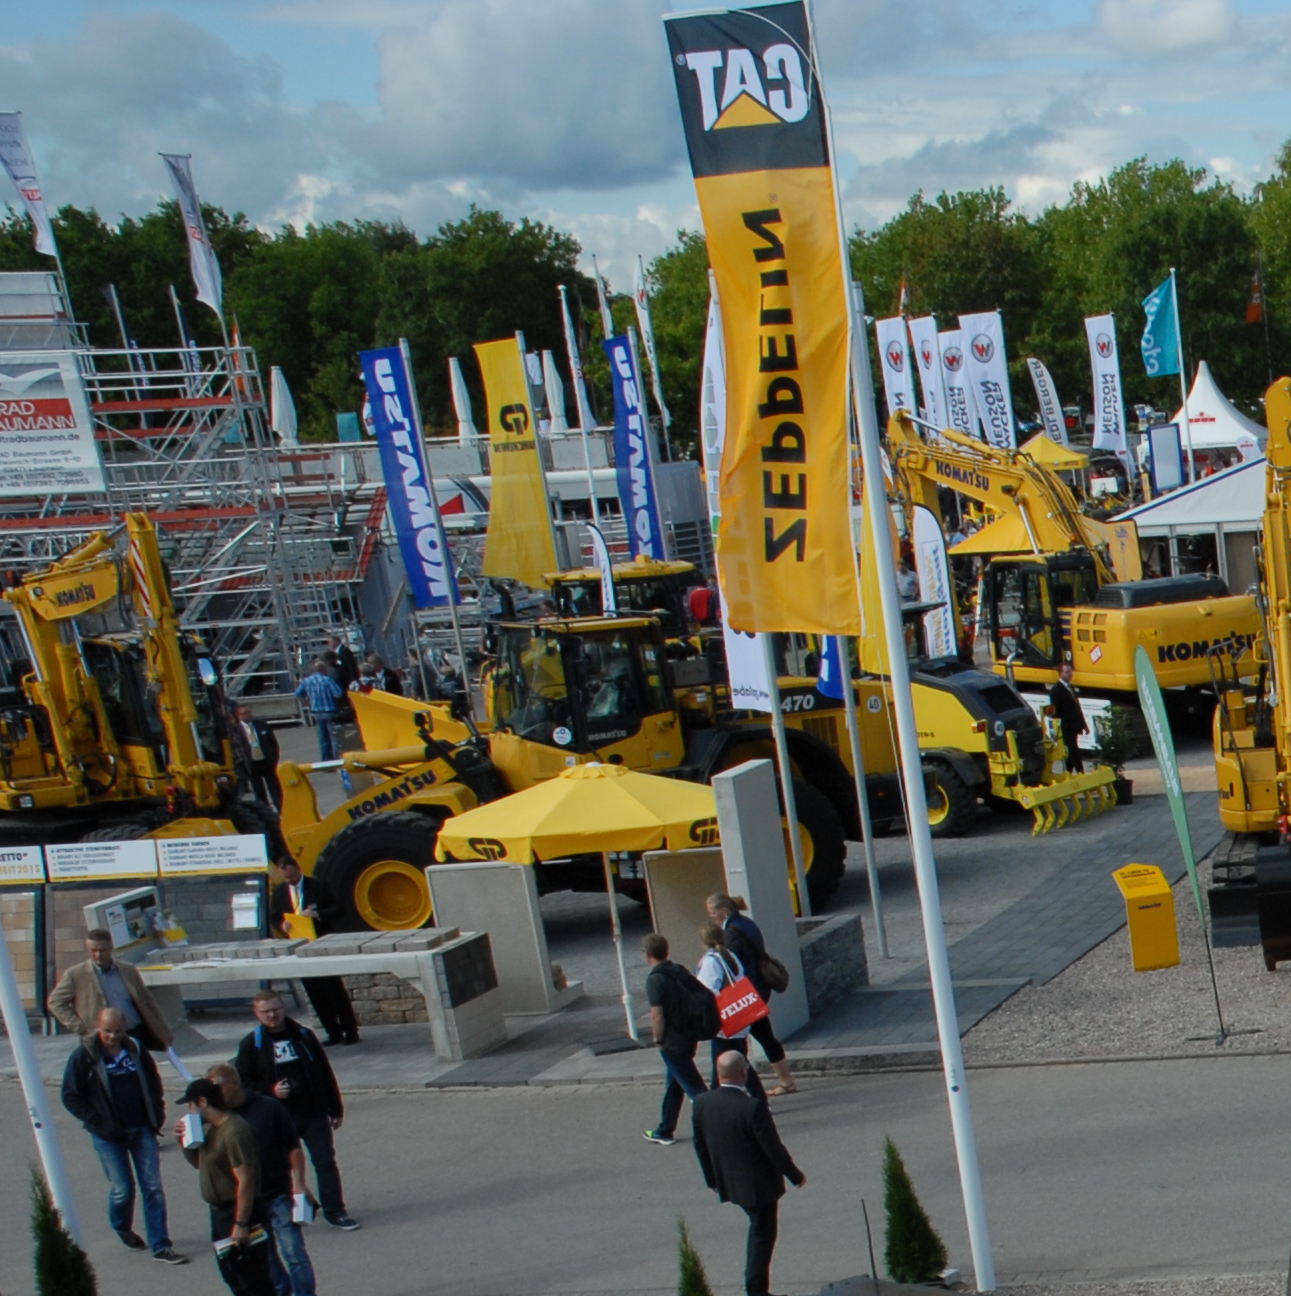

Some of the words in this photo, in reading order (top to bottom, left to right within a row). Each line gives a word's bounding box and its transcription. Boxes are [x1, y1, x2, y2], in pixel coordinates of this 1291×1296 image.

[936, 460, 990, 492] KOMATSU
[55, 583, 97, 609] KOMATSU
[780, 694, 815, 713] 470
[346, 769, 439, 821] KOMATSU
[720, 991, 759, 1020] VELUX
